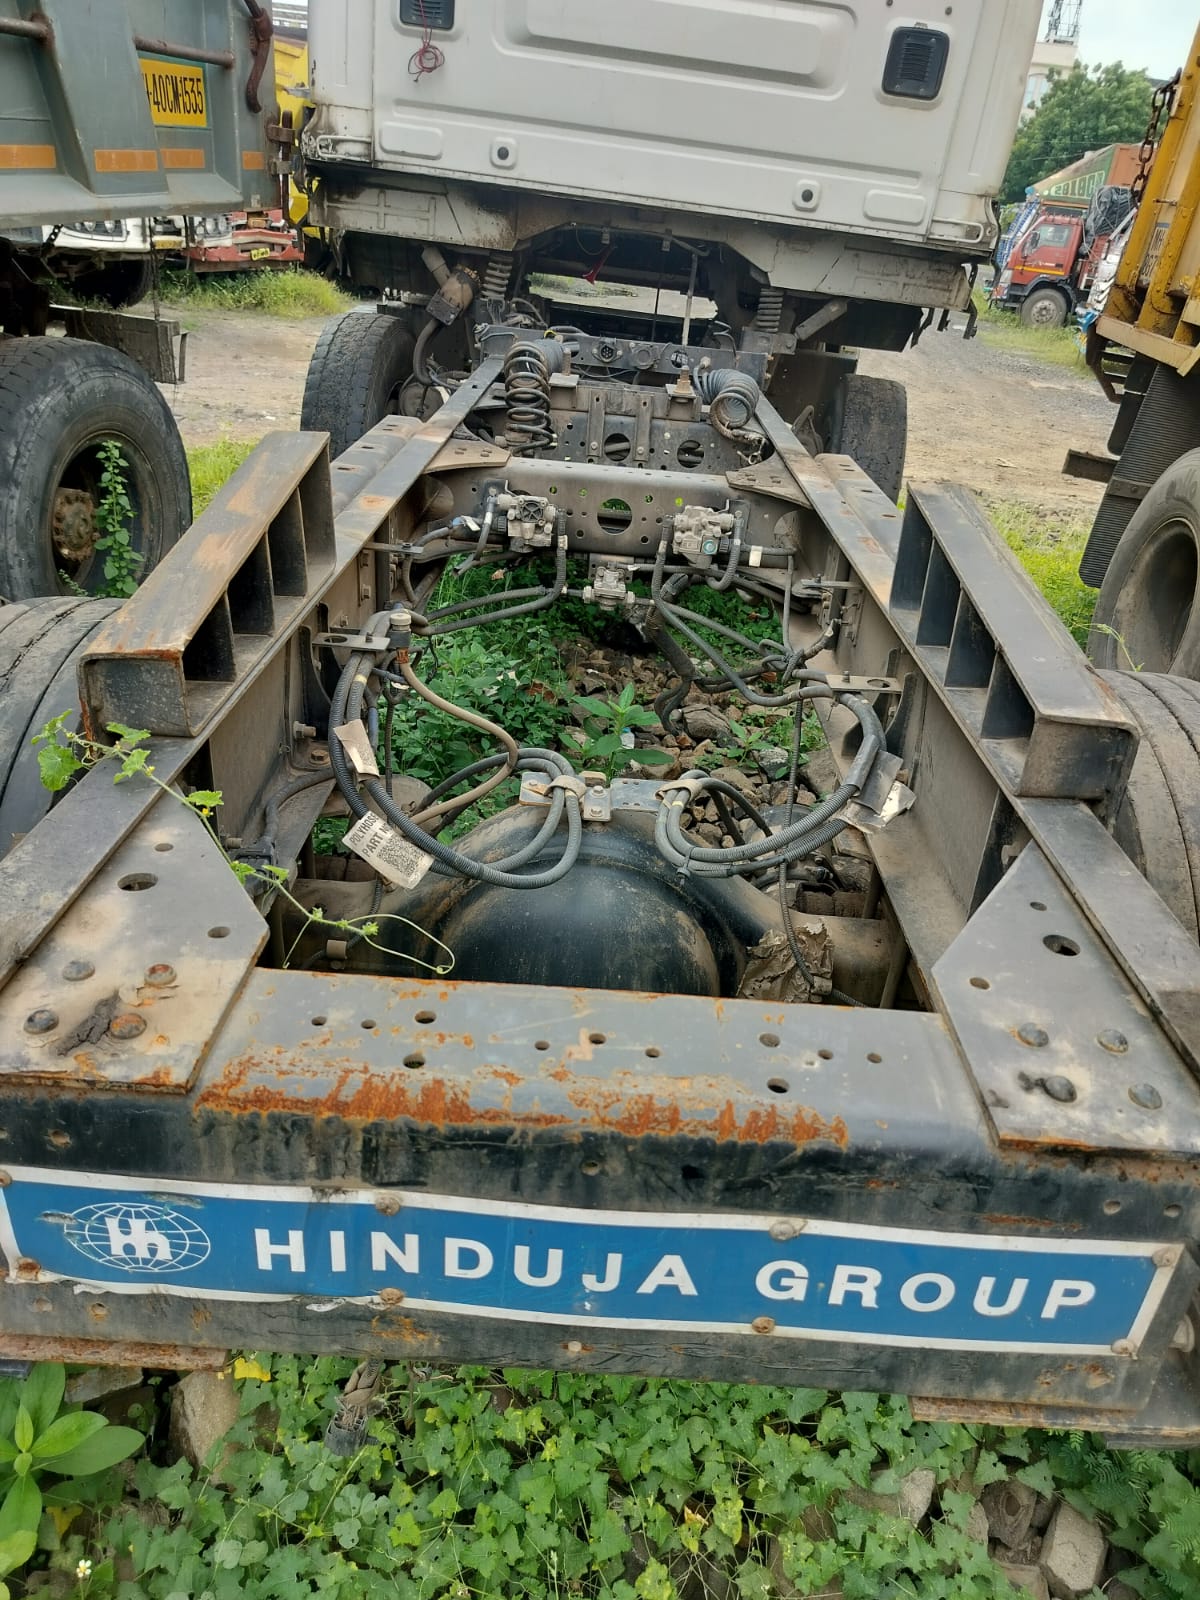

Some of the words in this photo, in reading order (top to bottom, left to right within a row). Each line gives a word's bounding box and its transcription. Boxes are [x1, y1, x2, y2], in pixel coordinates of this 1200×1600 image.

[362, 832, 383, 858] PART
[254, 1227, 698, 1296] HINDUJA
[755, 1260, 1096, 1319] GROUP
